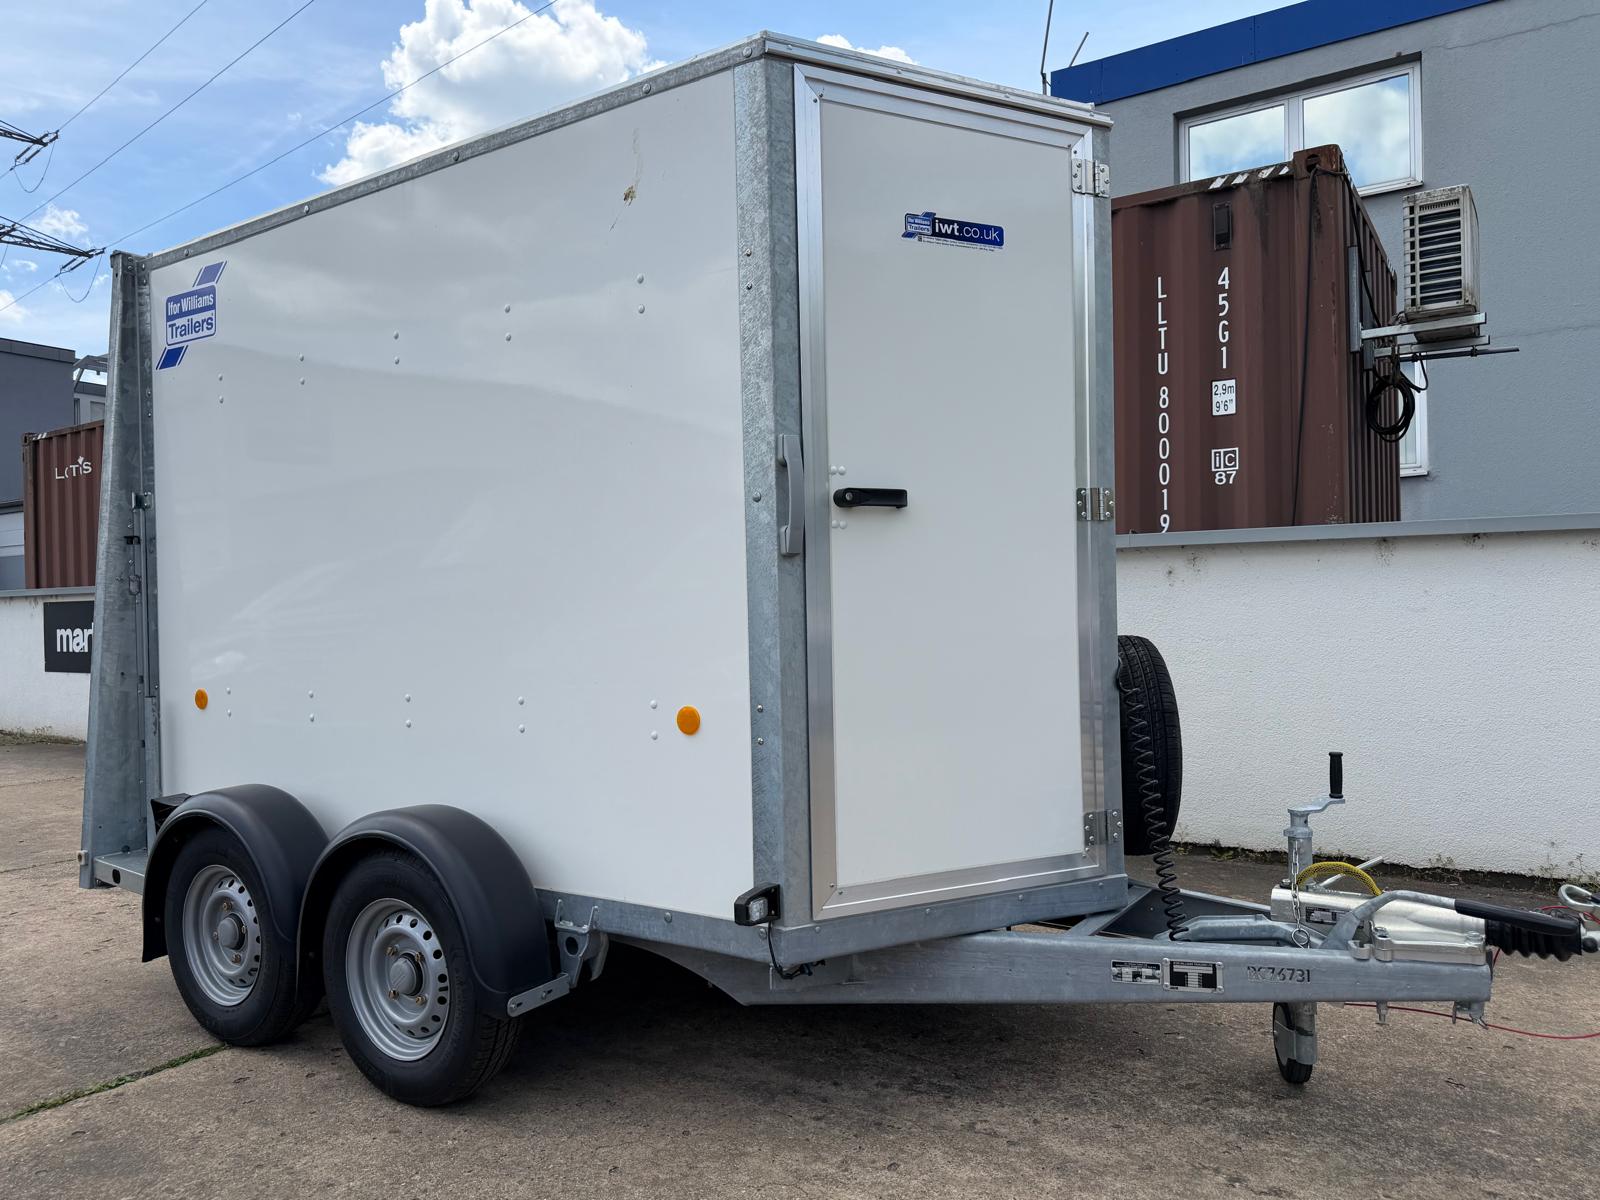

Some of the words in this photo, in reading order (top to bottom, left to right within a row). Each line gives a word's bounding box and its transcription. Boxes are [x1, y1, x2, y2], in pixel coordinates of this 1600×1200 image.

[935, 219, 1000, 242] iwt.co.uk
[168, 301, 180, 316] Ifor
[181, 294, 214, 313] Williams
[168, 316, 214, 339] Trailers
[1157, 276, 1168, 375] LLTU
[1217, 266, 1230, 369] 45G1
[1214, 471, 1236, 485] 87
[56, 622, 94, 653] mar
